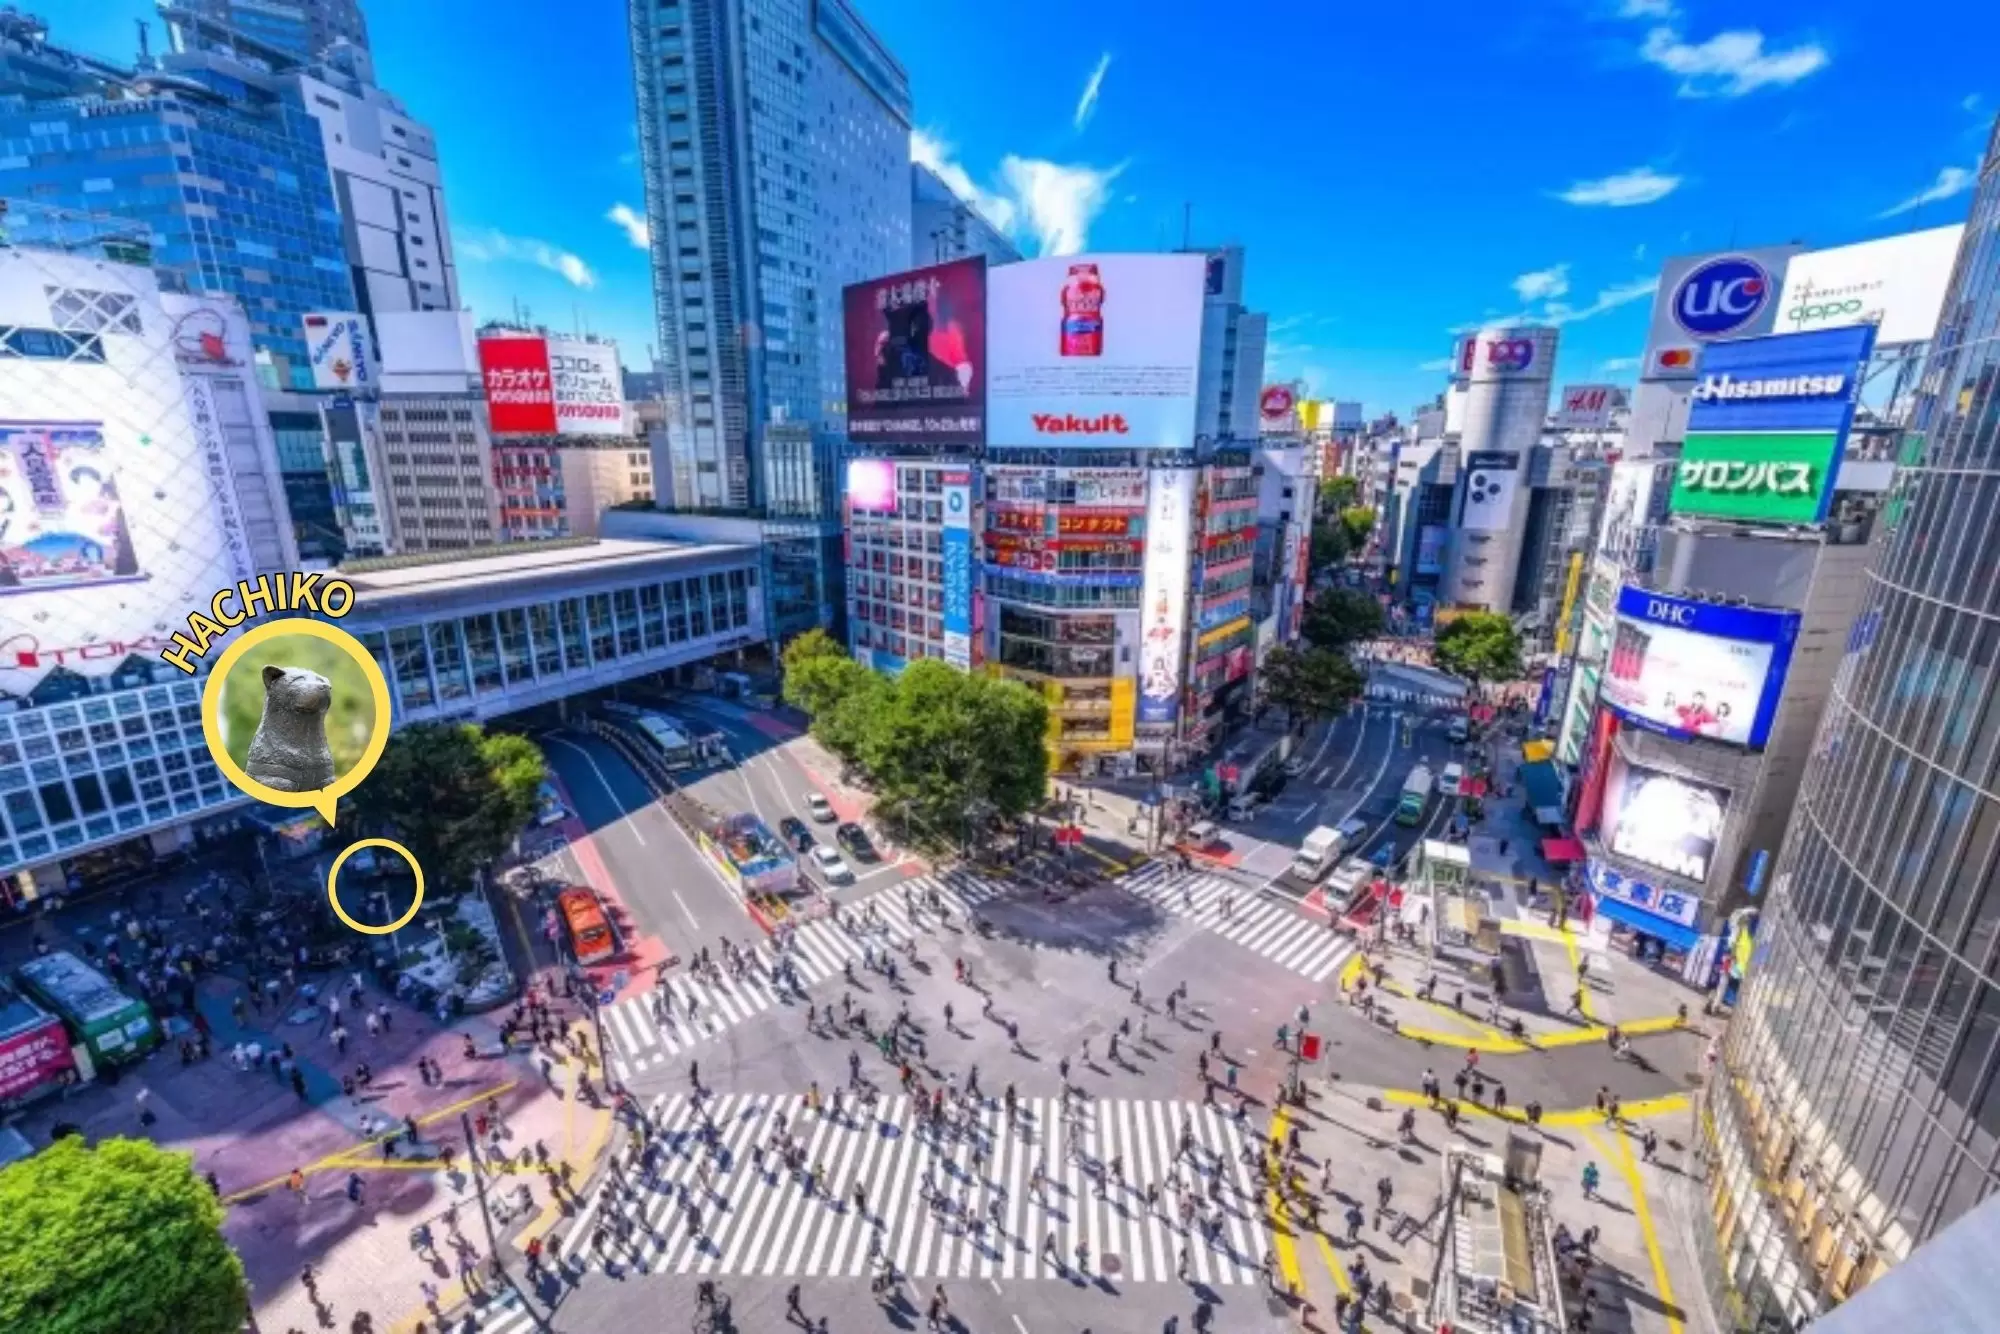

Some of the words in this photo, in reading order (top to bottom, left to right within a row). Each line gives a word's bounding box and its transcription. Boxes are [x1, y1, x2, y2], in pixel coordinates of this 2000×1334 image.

[1683, 275, 1764, 316] UC
[1788, 301, 1862, 324] oppo
[1487, 339, 1534, 371] 109
[486, 367, 549, 391] カラオケ
[1692, 374, 1844, 401] Hisamitsu
[1031, 413, 1130, 435] Yakult
[1679, 460, 1812, 493] サロンパス
[1647, 600, 1696, 626] DHC
